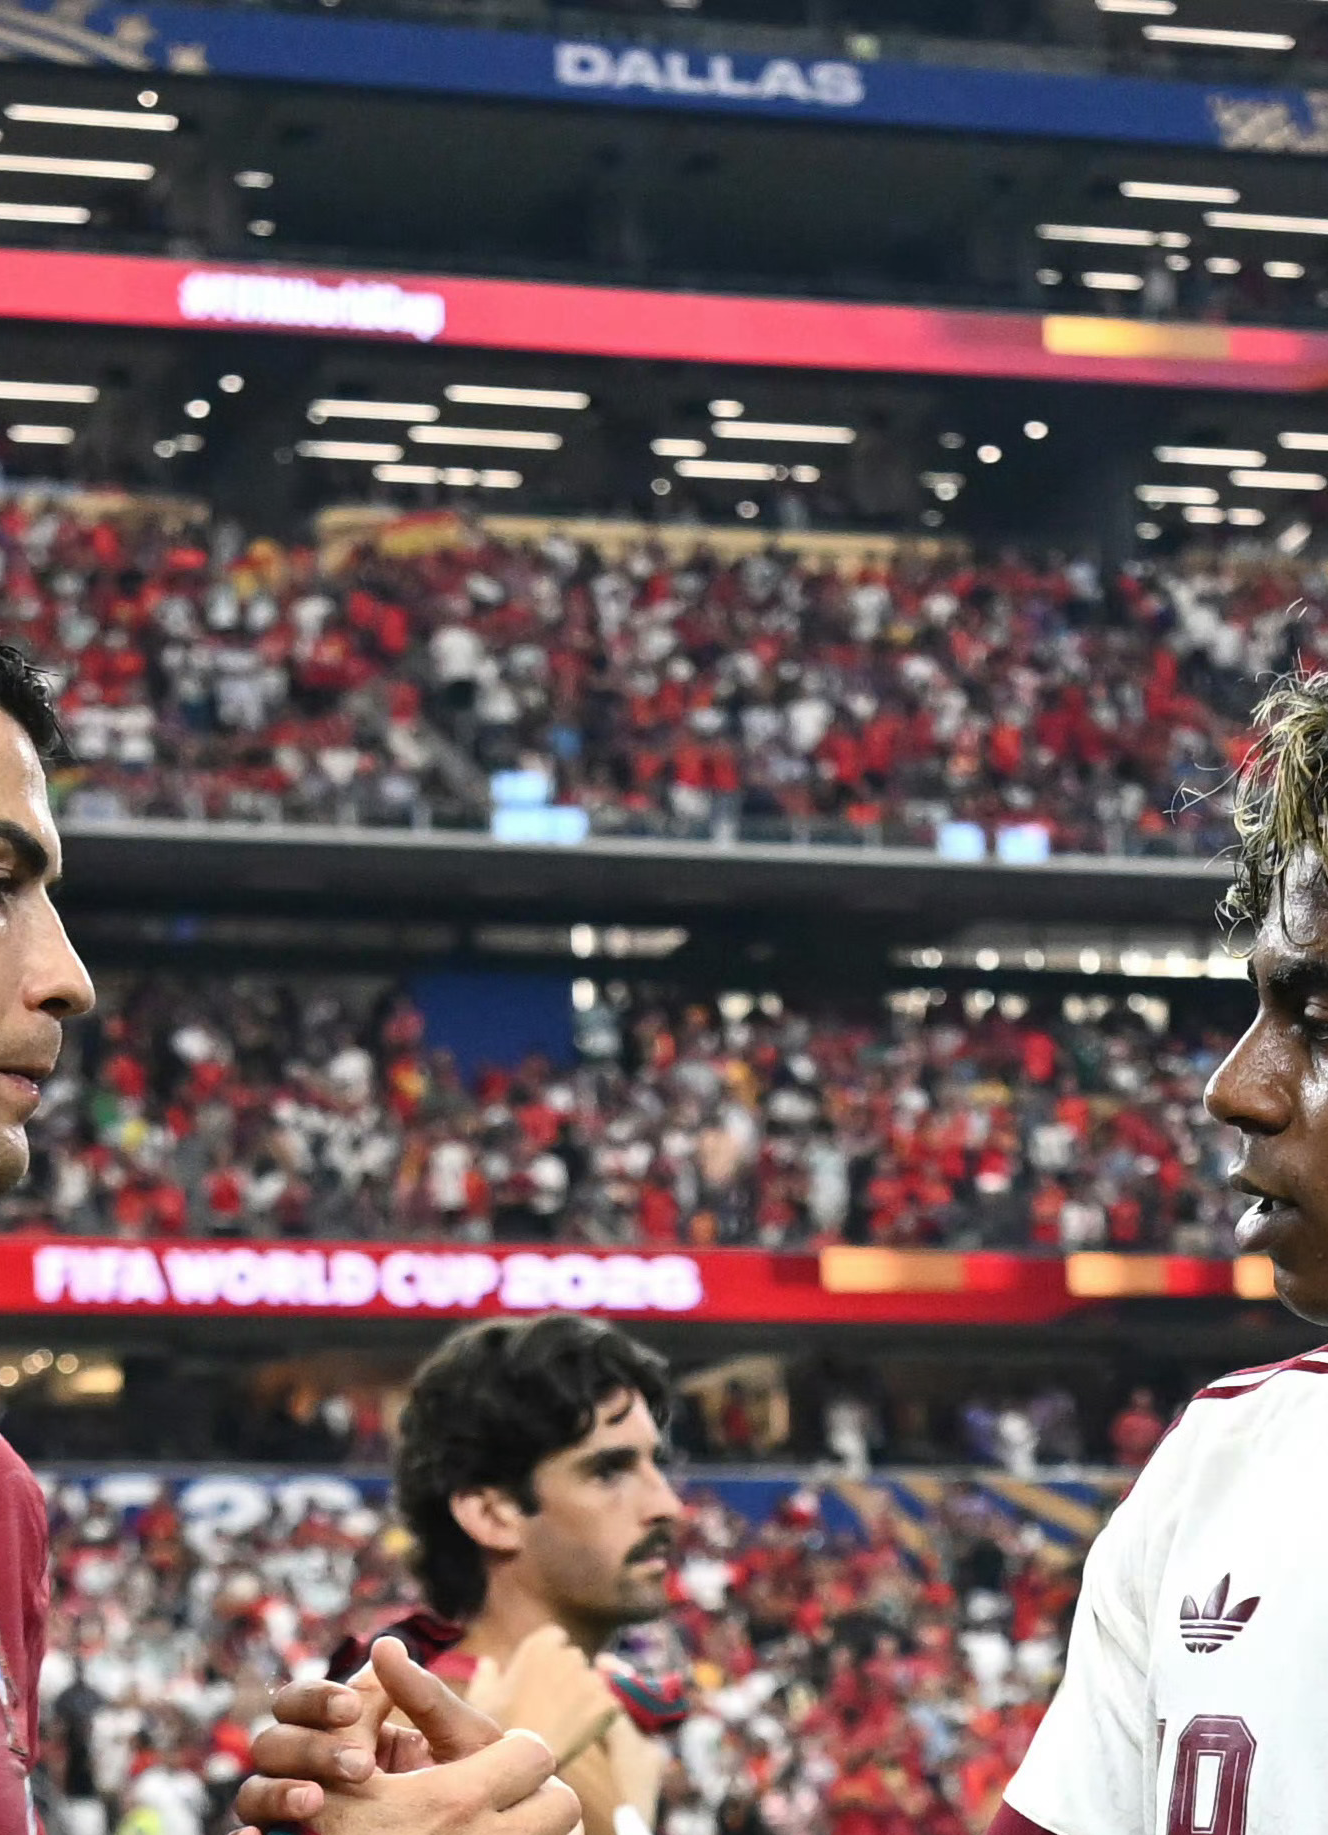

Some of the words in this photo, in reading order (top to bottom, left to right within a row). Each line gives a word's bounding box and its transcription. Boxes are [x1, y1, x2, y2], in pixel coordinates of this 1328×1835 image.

[553, 43, 865, 106] DALLAS
[33, 1245, 168, 1304] FIFA
[163, 1248, 379, 1307] WORLD
[380, 1251, 501, 1309] CUP
[499, 1255, 704, 1311] 2026
